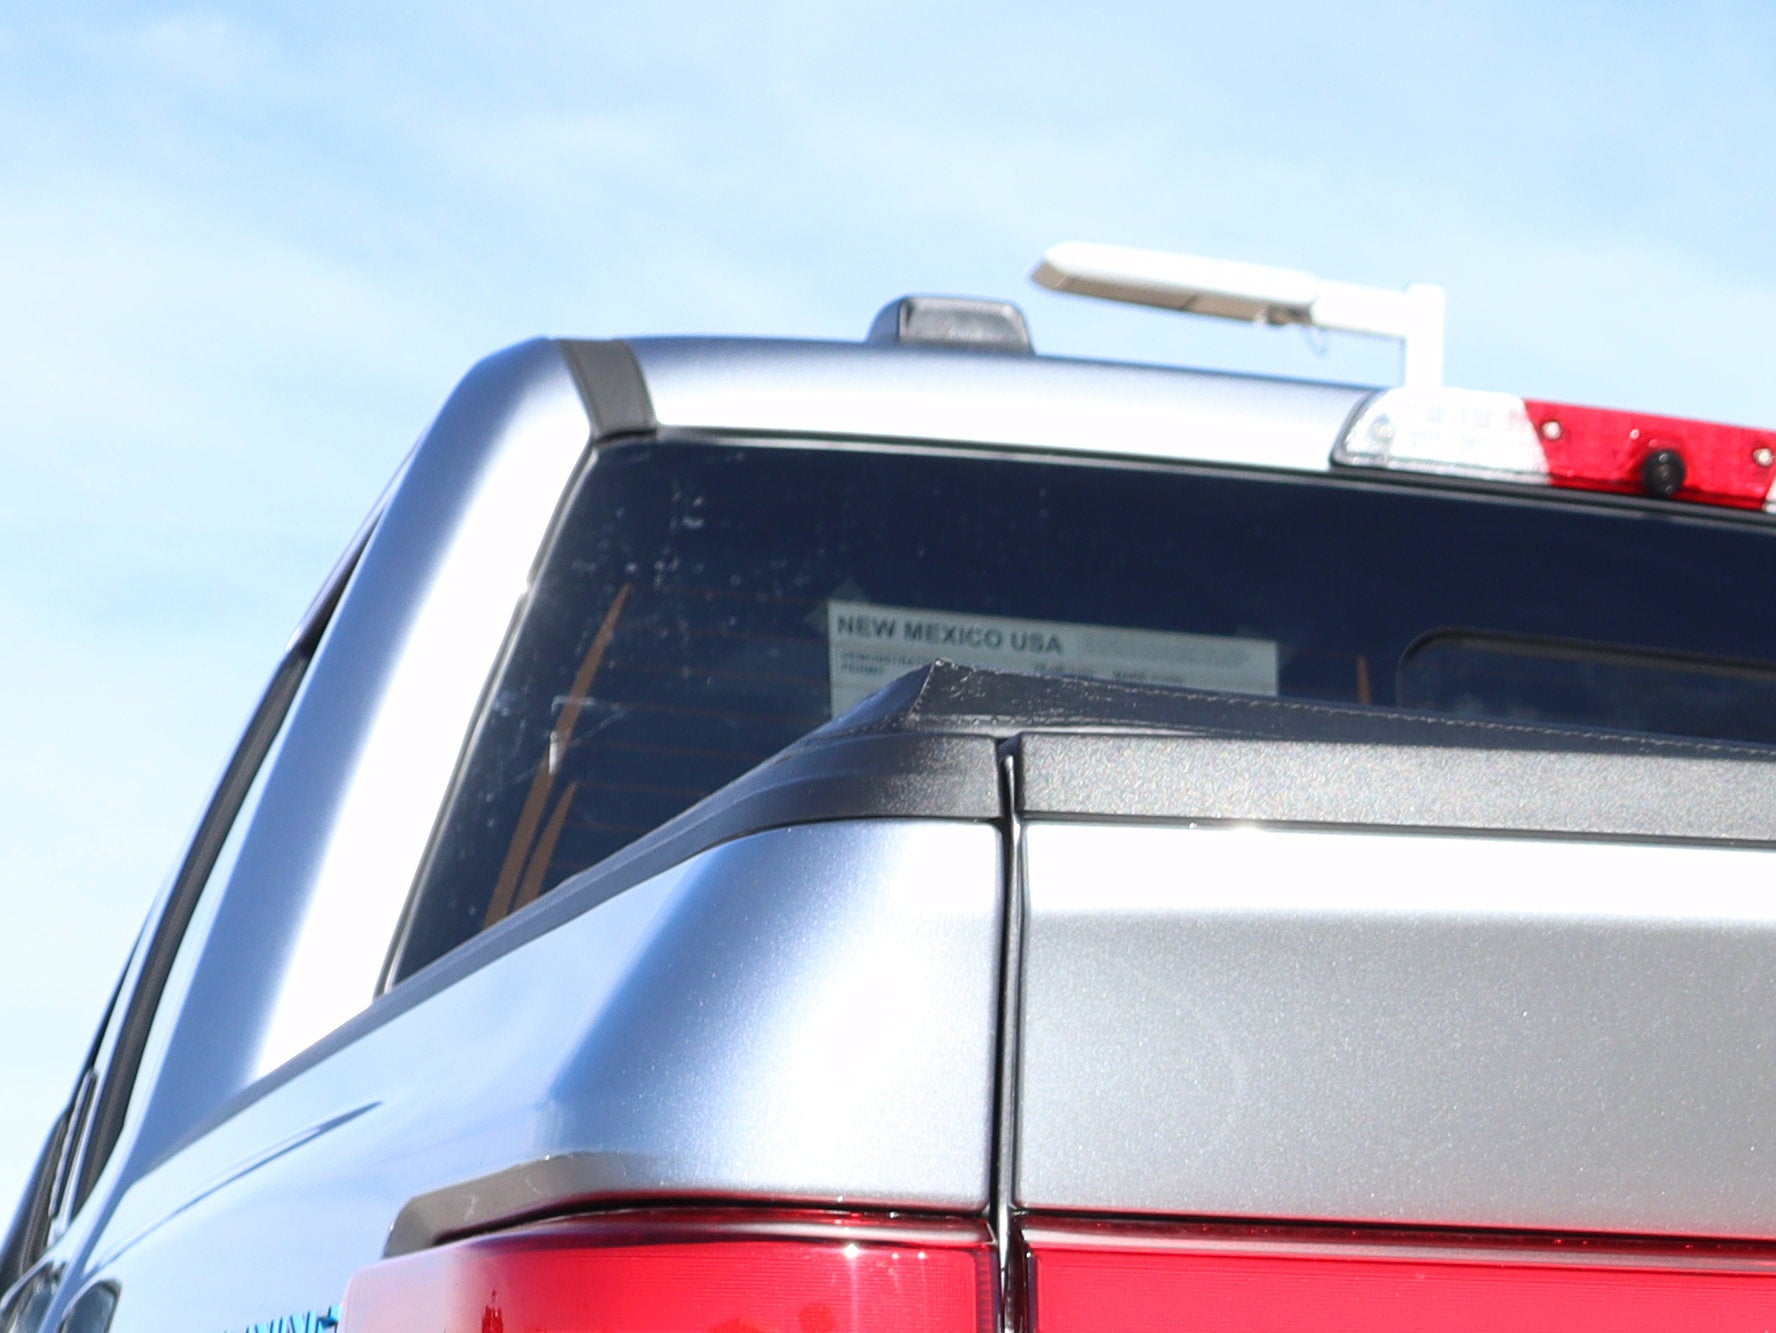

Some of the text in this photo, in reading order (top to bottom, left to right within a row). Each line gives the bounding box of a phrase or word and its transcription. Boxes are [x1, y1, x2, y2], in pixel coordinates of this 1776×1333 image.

[837, 615, 1065, 654] NEW MEXICO USA
